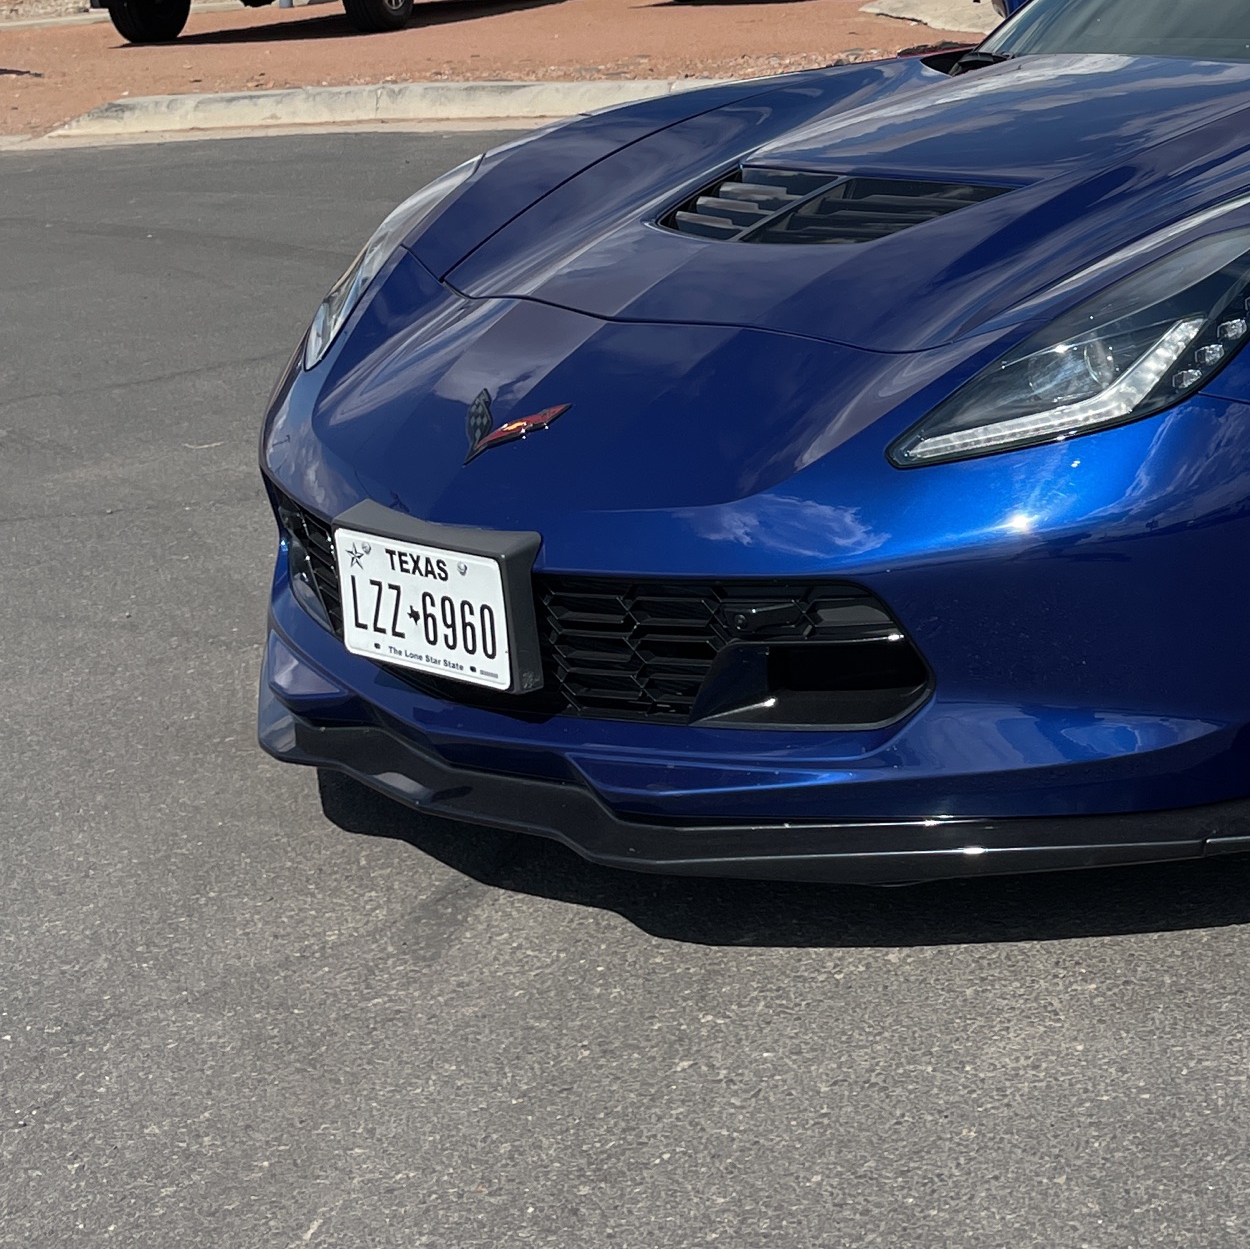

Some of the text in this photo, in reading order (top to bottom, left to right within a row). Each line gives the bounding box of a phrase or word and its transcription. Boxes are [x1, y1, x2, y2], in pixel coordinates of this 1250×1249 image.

[385, 548, 449, 581] TEXAS
[388, 645, 464, 671] The Lone Star State
